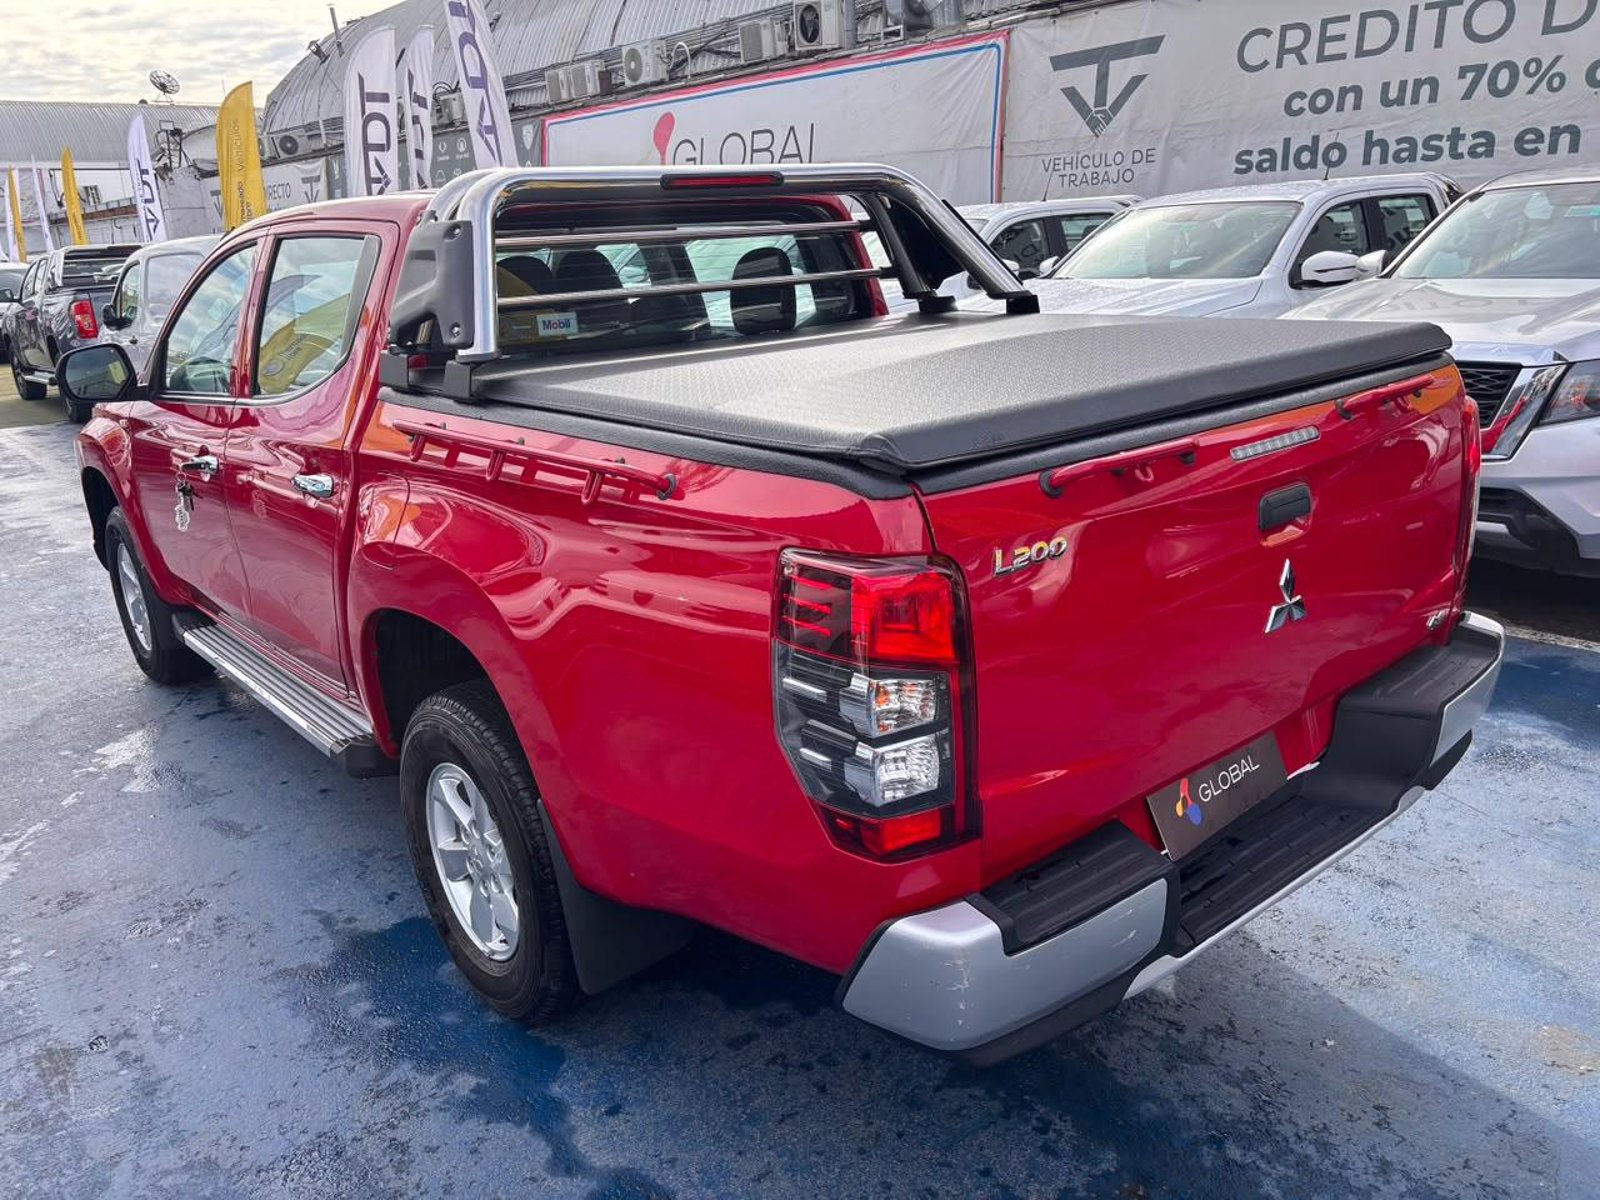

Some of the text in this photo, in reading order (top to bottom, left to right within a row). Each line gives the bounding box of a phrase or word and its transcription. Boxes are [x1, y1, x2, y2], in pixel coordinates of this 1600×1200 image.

[1236, 0, 1517, 73] CREDITO
[1283, 84, 1364, 117] con
[1379, 75, 1440, 109] un
[1457, 54, 1568, 101] 70%
[1131, 147, 1157, 165] DE
[1233, 123, 1582, 175] saldo hasta en
[268, 182, 291, 200] RECTO
[1058, 168, 1135, 188] TRABAJO
[542, 319, 571, 331] Mobil
[994, 536, 1068, 577] L200
[1198, 755, 1260, 802] GLOBAL
